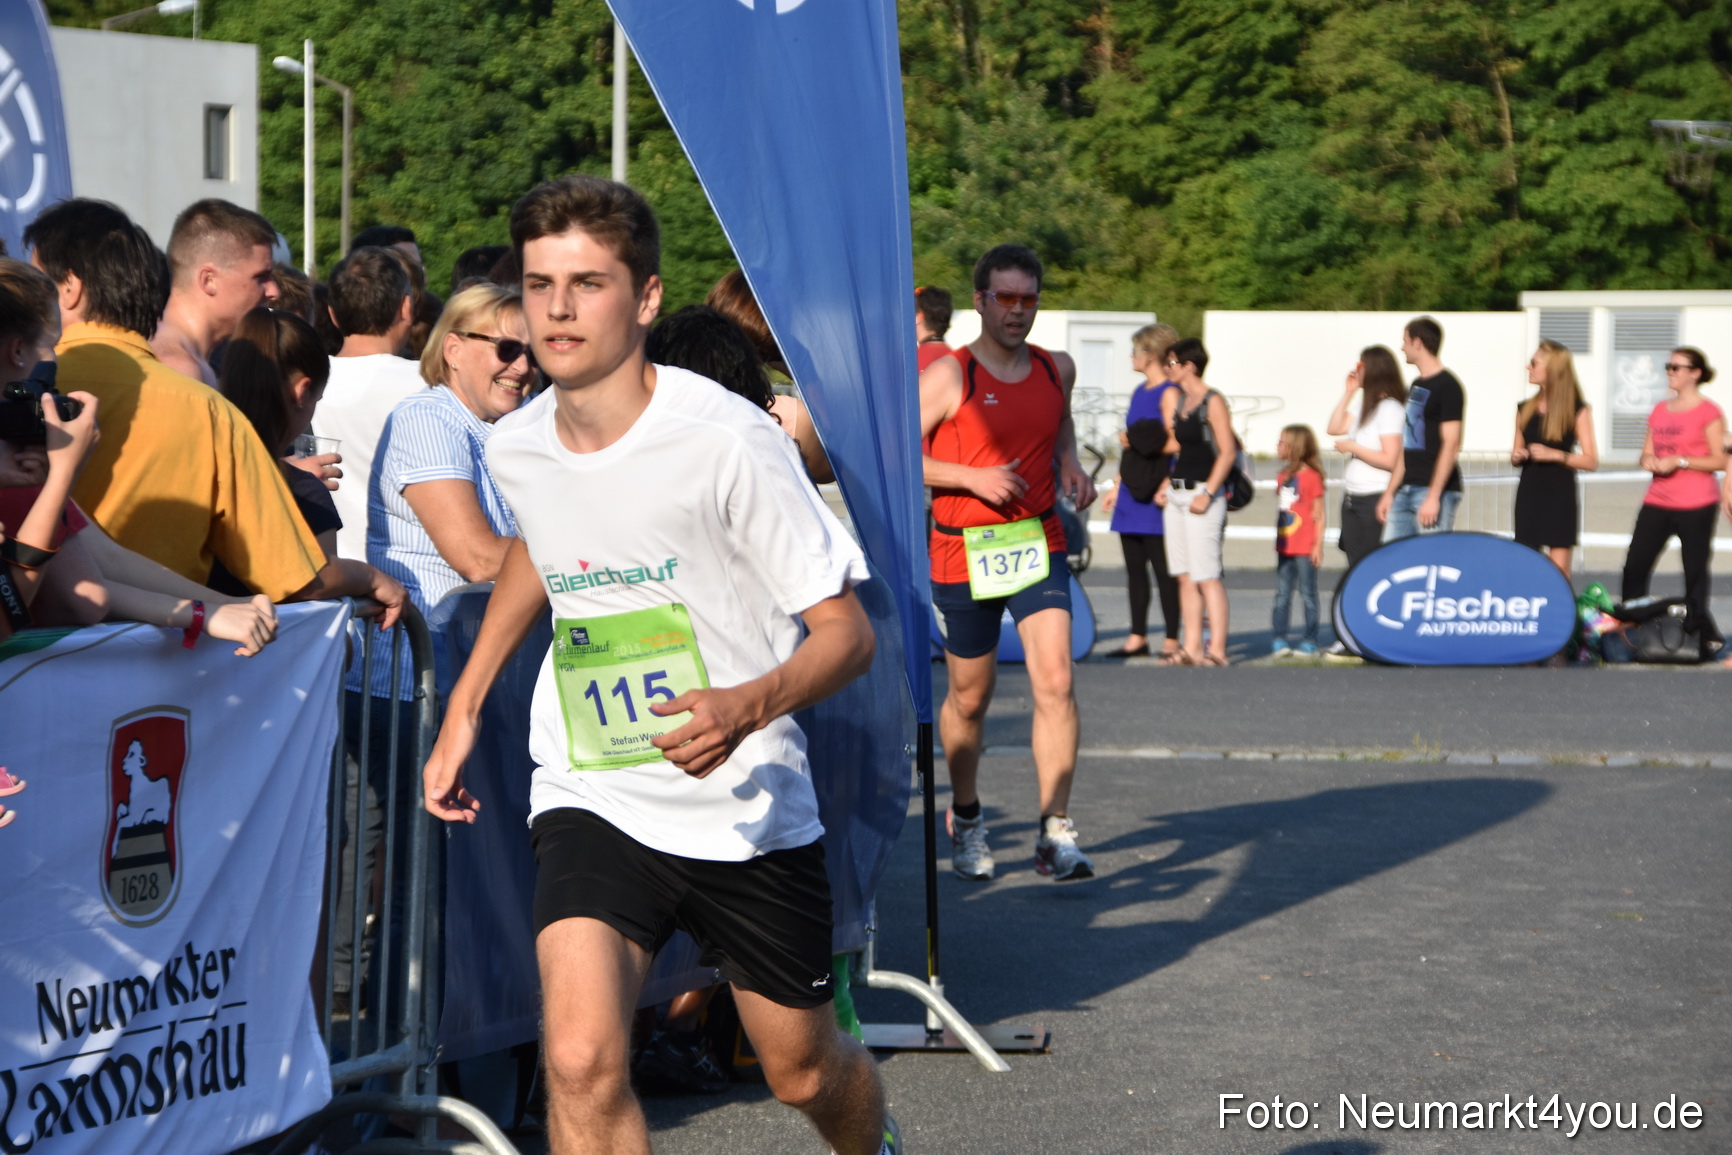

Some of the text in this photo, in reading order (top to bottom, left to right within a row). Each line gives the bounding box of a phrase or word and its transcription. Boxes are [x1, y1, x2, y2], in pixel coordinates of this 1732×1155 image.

[545, 557, 678, 593] Gleichauf
[978, 547, 1040, 576] 1372
[0, 574, 21, 615] SONY
[1401, 589, 1548, 620] Fischer
[1416, 620, 1539, 637] AUTOMOBILE
[584, 669, 676, 726] 115
[610, 736, 639, 746] Stefan
[121, 872, 159, 904] 1628
